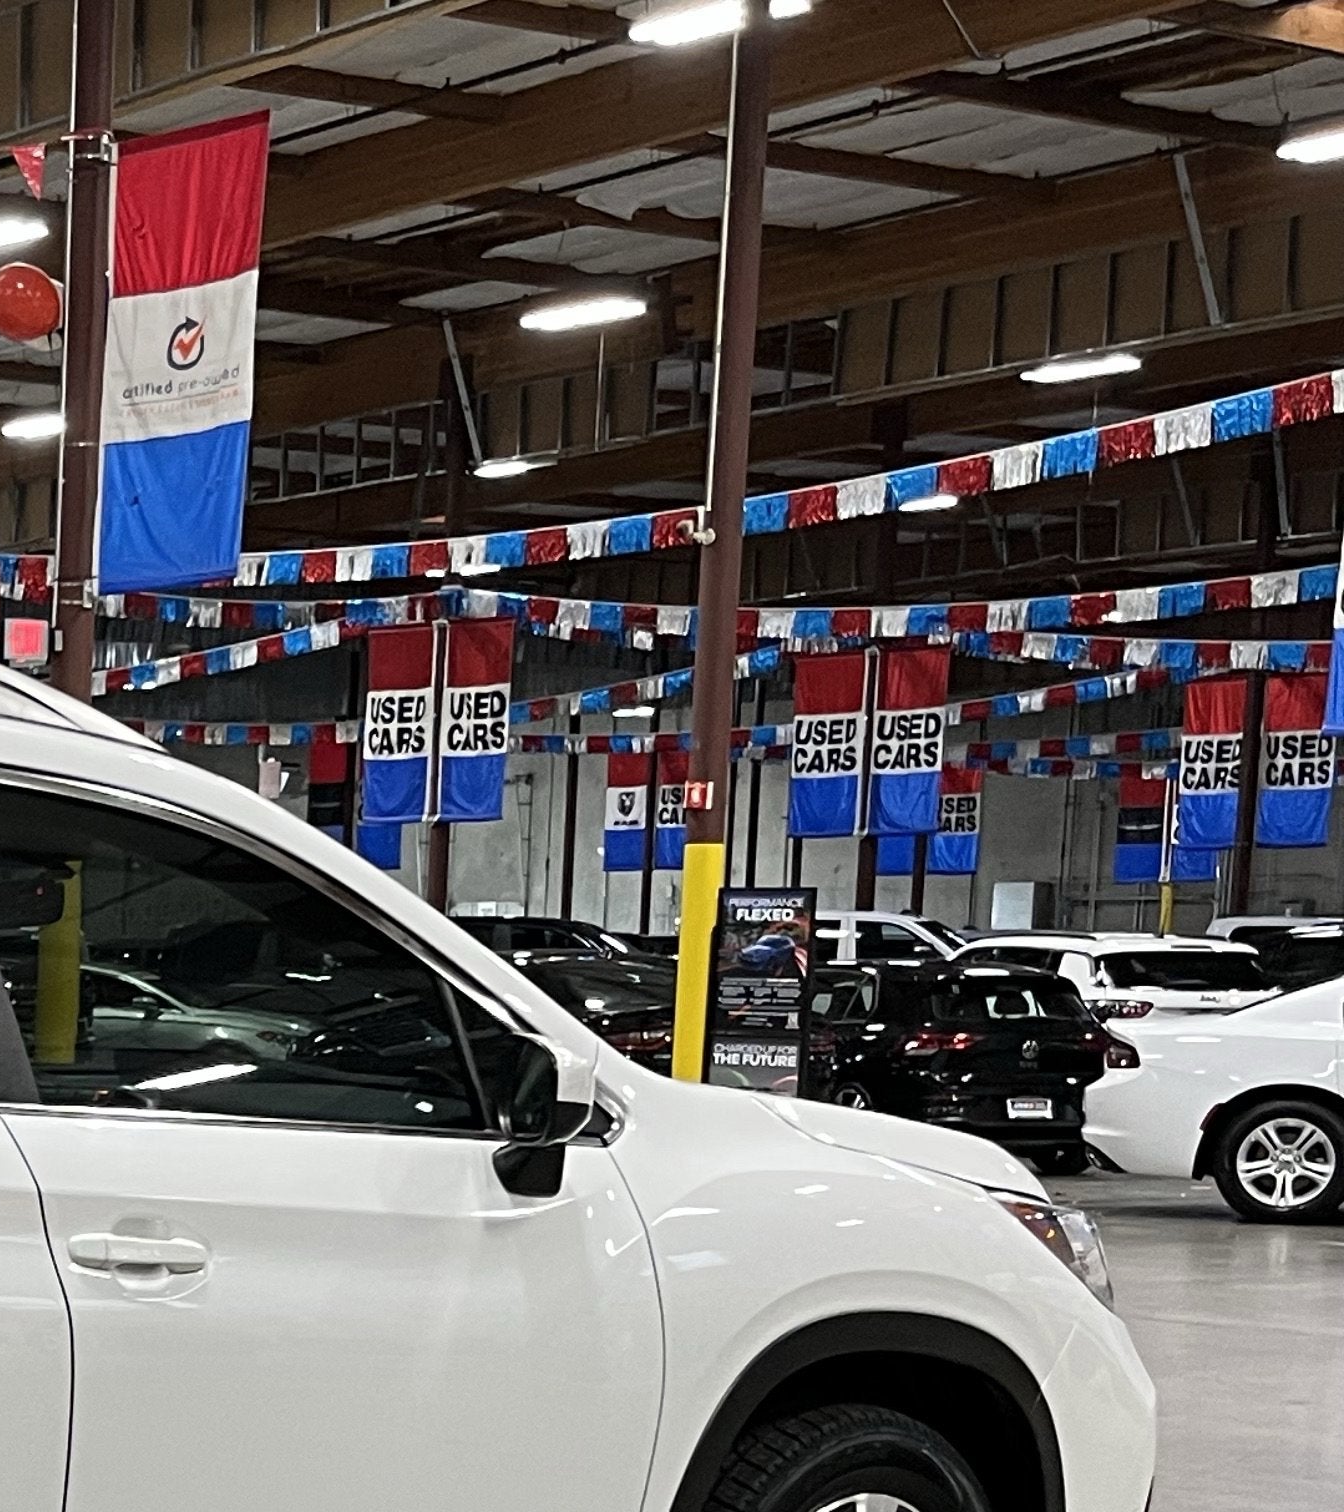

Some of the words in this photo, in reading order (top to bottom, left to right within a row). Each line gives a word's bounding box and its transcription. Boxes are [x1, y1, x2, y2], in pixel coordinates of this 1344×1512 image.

[370, 694, 426, 725] USED
[450, 690, 507, 720] USED
[447, 721, 506, 751] CARS
[795, 718, 857, 746] USED
[876, 712, 941, 741] USED
[368, 725, 426, 755] CARS
[1184, 738, 1242, 764] USED
[1266, 734, 1333, 760] USED
[794, 746, 857, 773] CARS
[873, 741, 939, 770] CARS
[1182, 765, 1240, 790] CARS
[1265, 760, 1331, 786] CARS
[661, 787, 682, 805] US
[938, 814, 977, 832] ARS
[735, 908, 795, 922] FLEXED
[713, 1052, 740, 1065] THE
[741, 1053, 797, 1068] FUTURE
